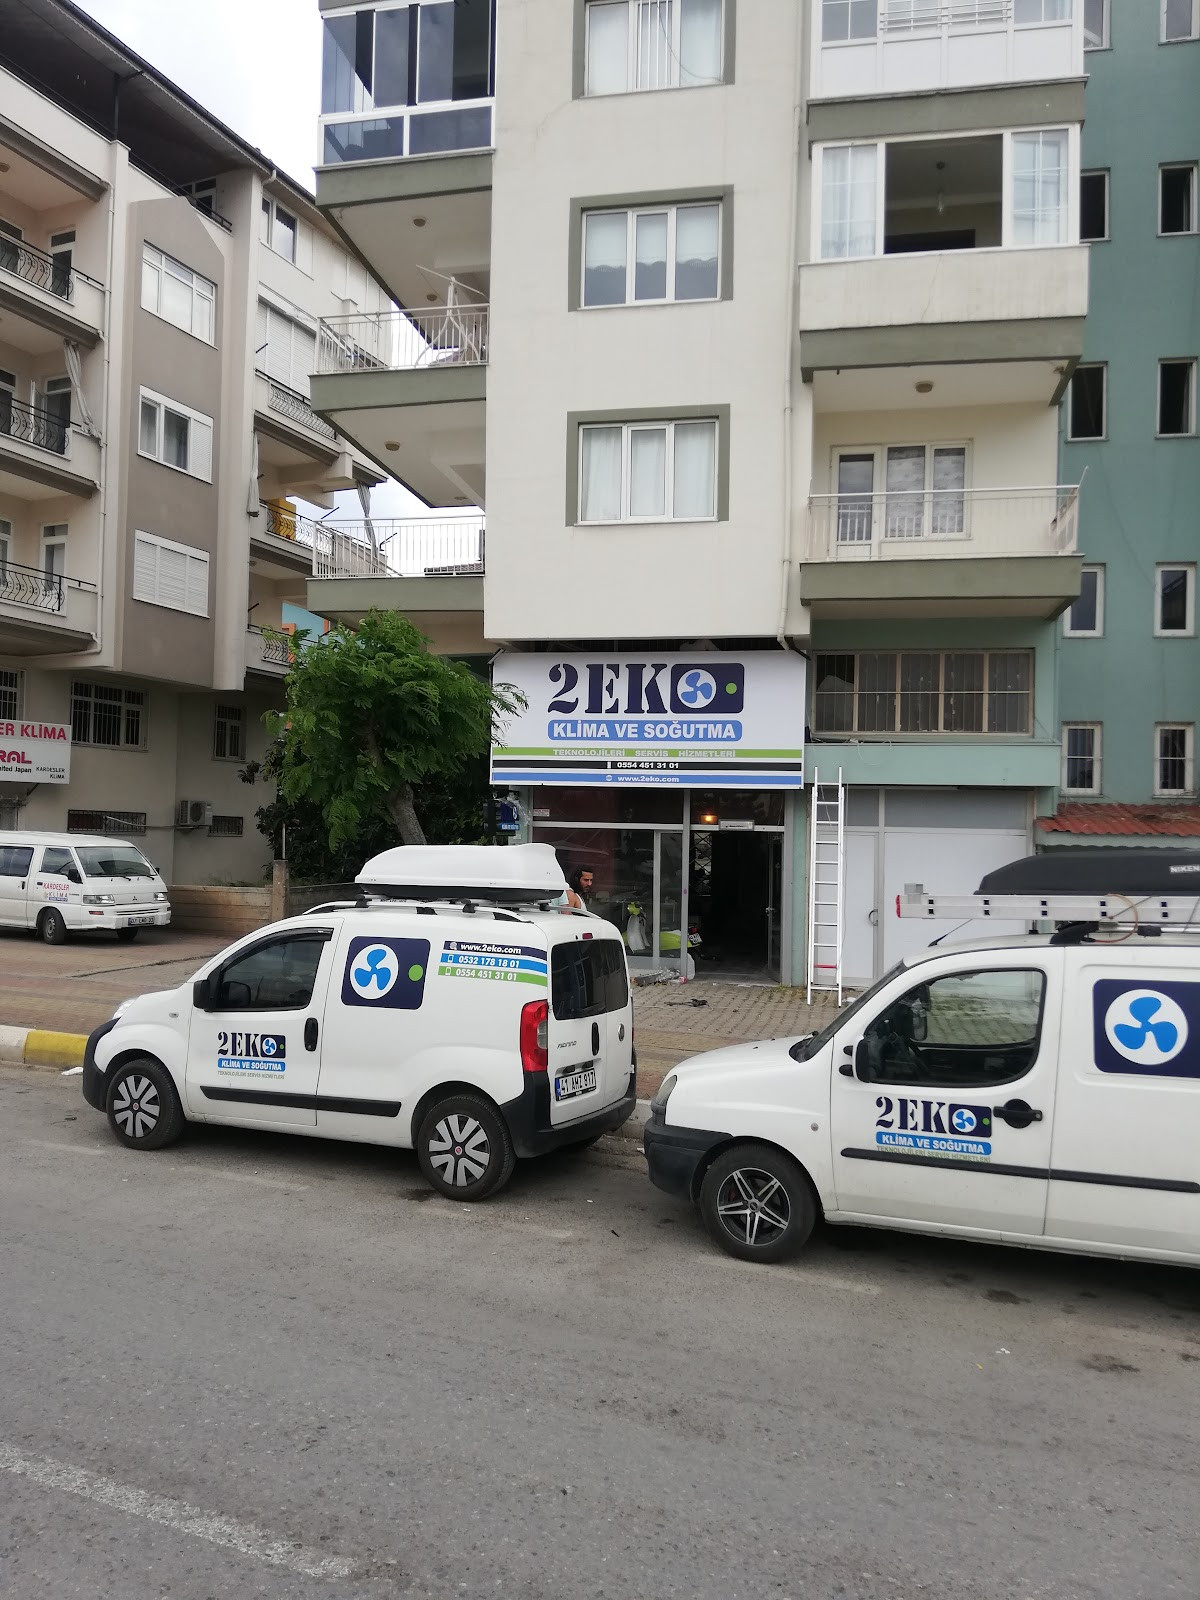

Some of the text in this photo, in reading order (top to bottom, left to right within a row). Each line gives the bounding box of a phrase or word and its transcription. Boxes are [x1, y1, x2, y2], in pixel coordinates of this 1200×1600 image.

[553, 720, 736, 739] KLİMA VE SOĞUTMA
[554, 749, 626, 757] TEKNOLOJİLERİ
[678, 749, 736, 758] HİZMETLERİ
[617, 775, 680, 783] www.2eko.com
[461, 944, 521, 954] www.2eko.com
[459, 956, 519, 968] 0532 178 18 01
[456, 969, 475, 977] 0554
[222, 1060, 240, 1068] KLİMA
[251, 1062, 281, 1071] SOĞUTMA
[882, 1134, 985, 1154] KLİMA VE SOĞUTMA
